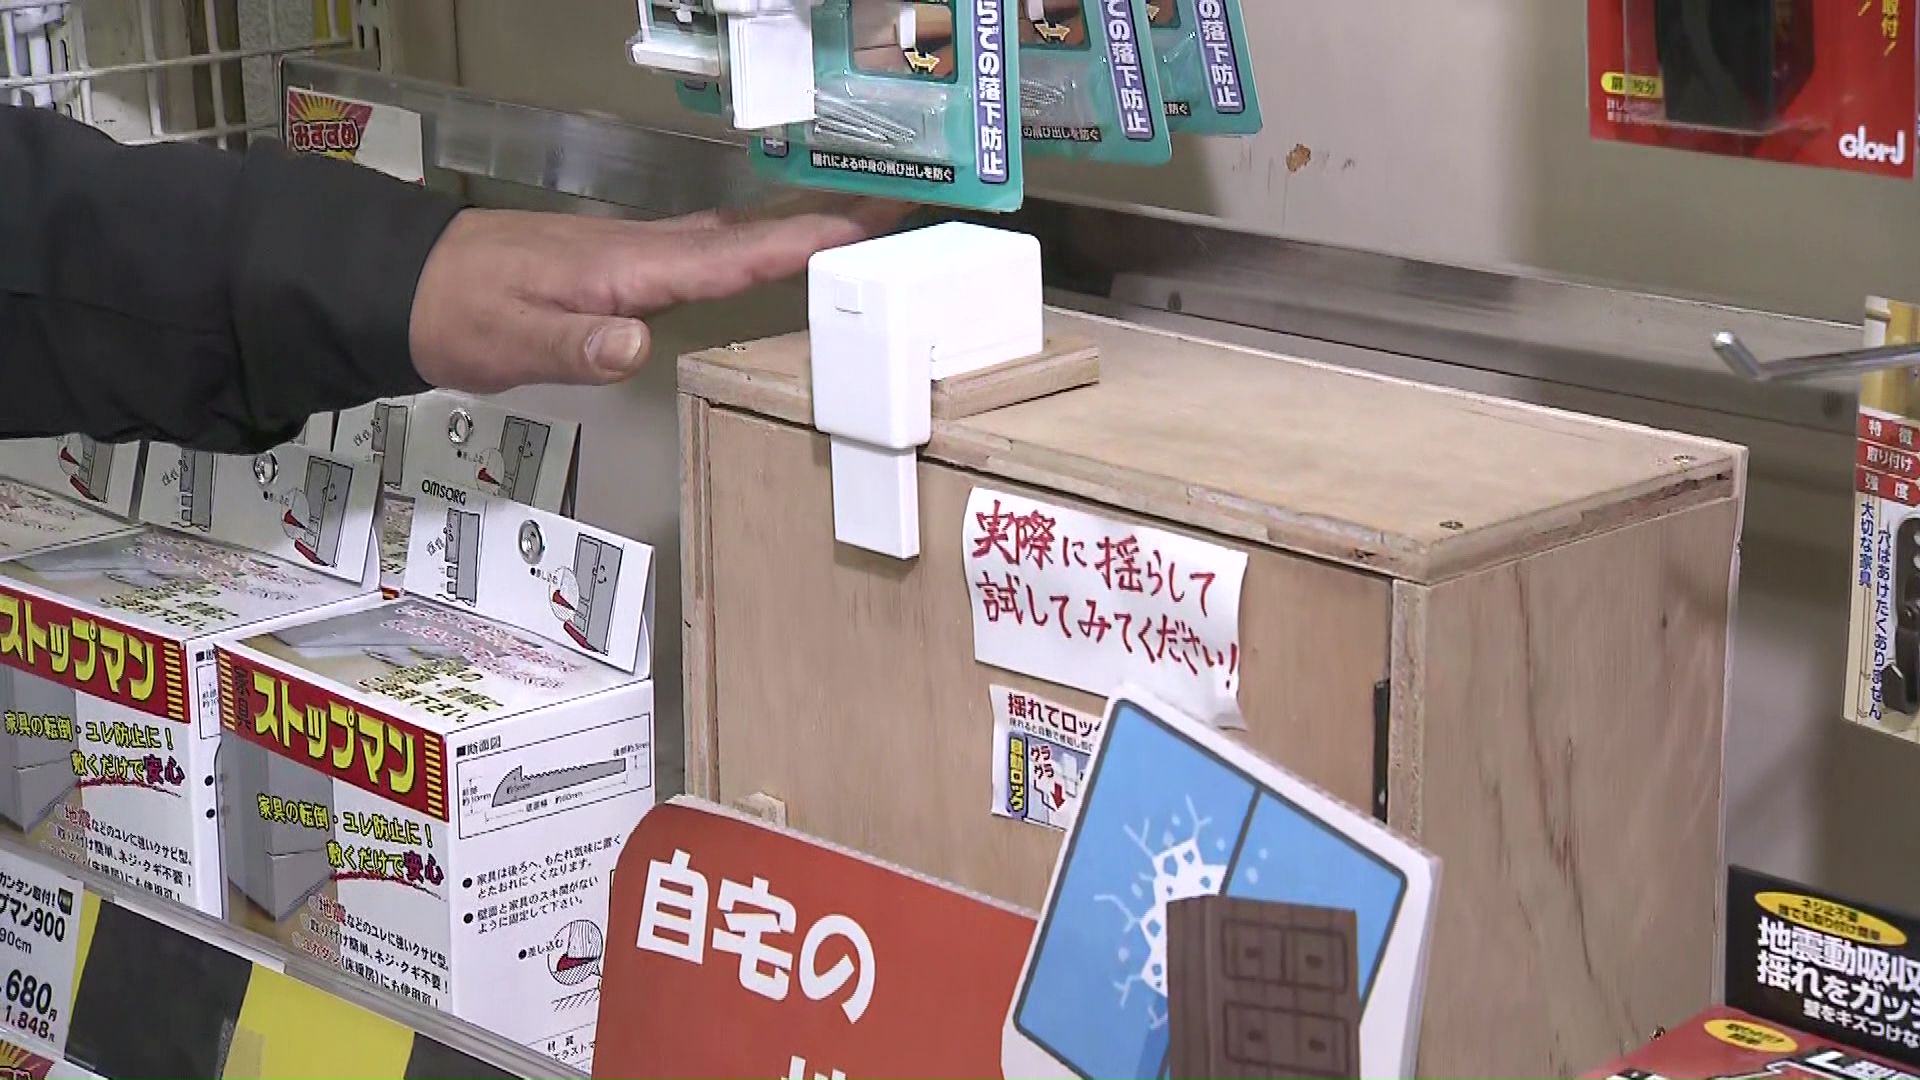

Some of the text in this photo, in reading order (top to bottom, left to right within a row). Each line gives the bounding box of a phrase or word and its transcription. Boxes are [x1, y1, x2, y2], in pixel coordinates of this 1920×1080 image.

[1867, 445, 1912, 472] 取り付け
[972, 500, 1215, 617] 実際に揺らして
[975, 571, 1238, 689] 試してみてください！
[70, 750, 185, 786] 敷くだけで安心
[252, 671, 416, 794] ストップマン
[257, 793, 434, 848] 家具の転倒・ユレ防止に！
[327, 841, 445, 887] 敷くだけで安心
[637, 849, 876, 1024] 自宅の
[1757, 916, 1920, 995] 地震動吸収
